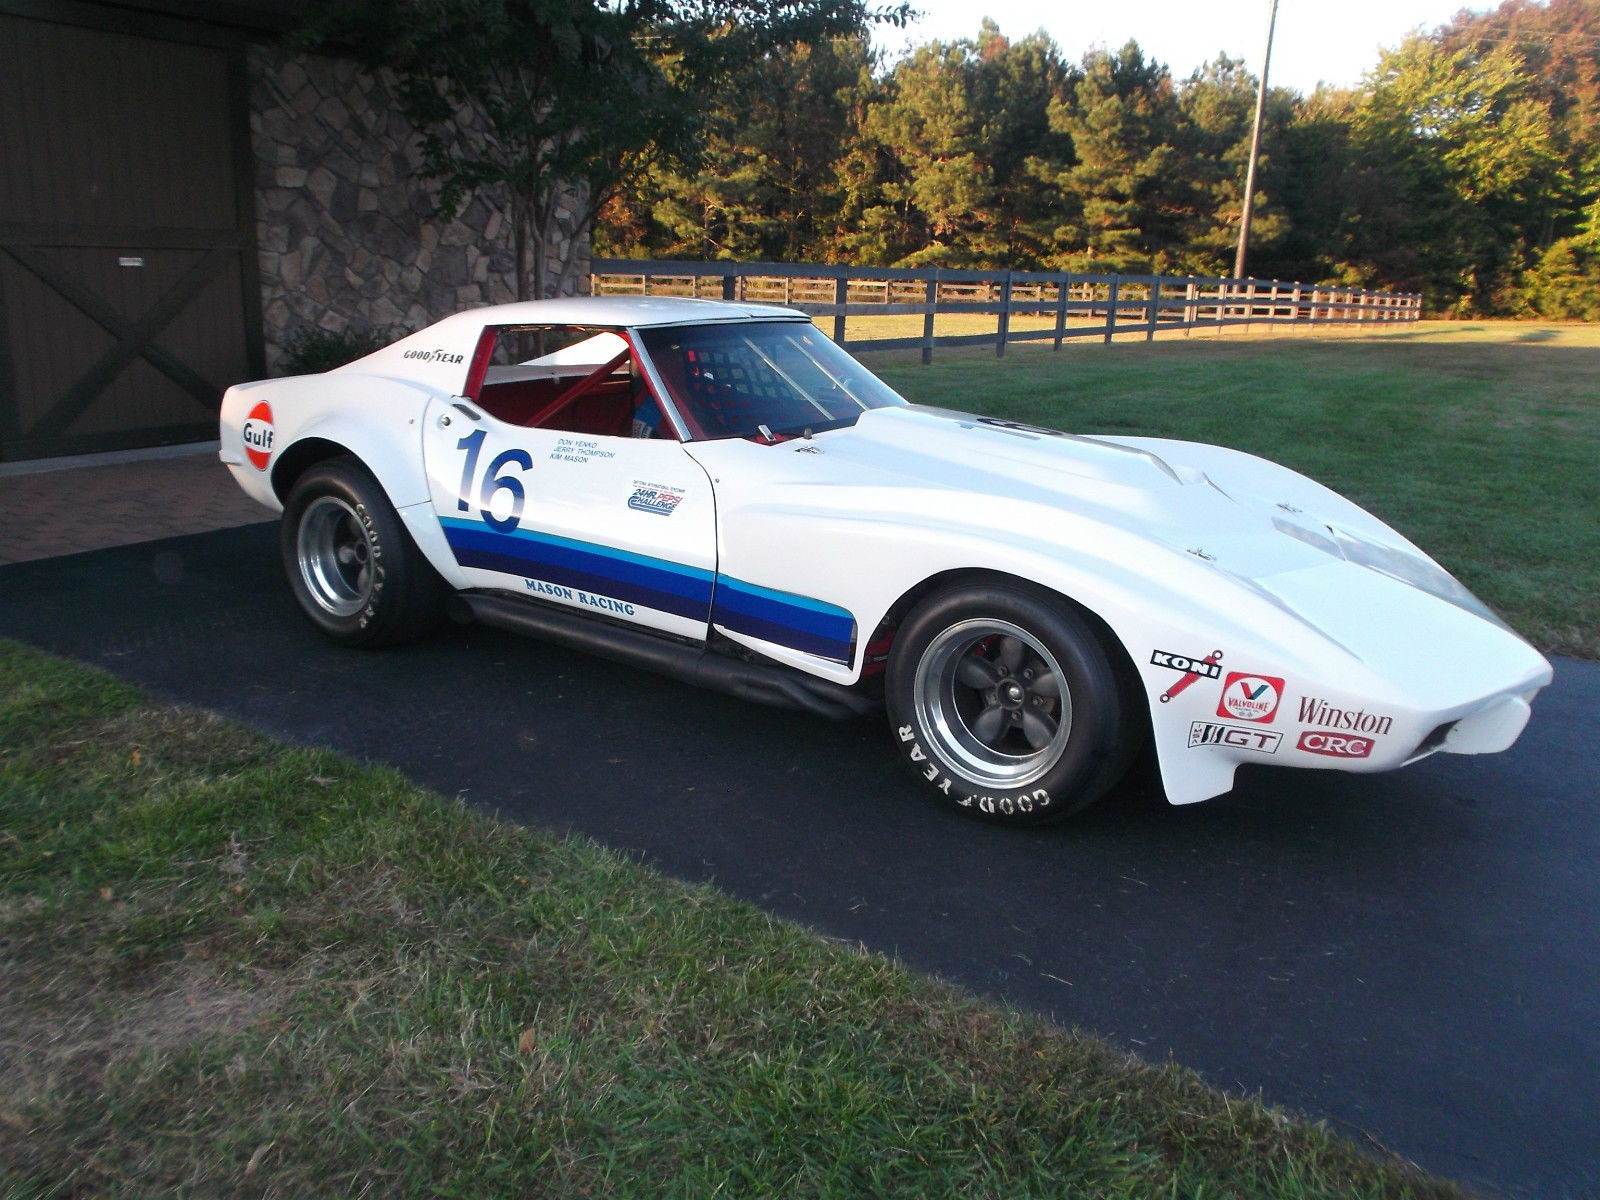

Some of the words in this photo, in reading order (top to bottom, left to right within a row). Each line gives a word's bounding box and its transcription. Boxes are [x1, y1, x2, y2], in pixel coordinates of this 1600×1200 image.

[243, 422, 274, 449] Gulf
[564, 454, 589, 463] MASON
[577, 448, 616, 459] THOMPSON
[457, 429, 533, 534] 16
[524, 579, 573, 600] MASON
[578, 591, 636, 616] RACING
[1154, 652, 1220, 677] KONI
[1228, 696, 1270, 713] VALVOLINE
[1298, 696, 1393, 735] Winston
[1224, 729, 1277, 749] GT
[1304, 734, 1367, 755] CRC
